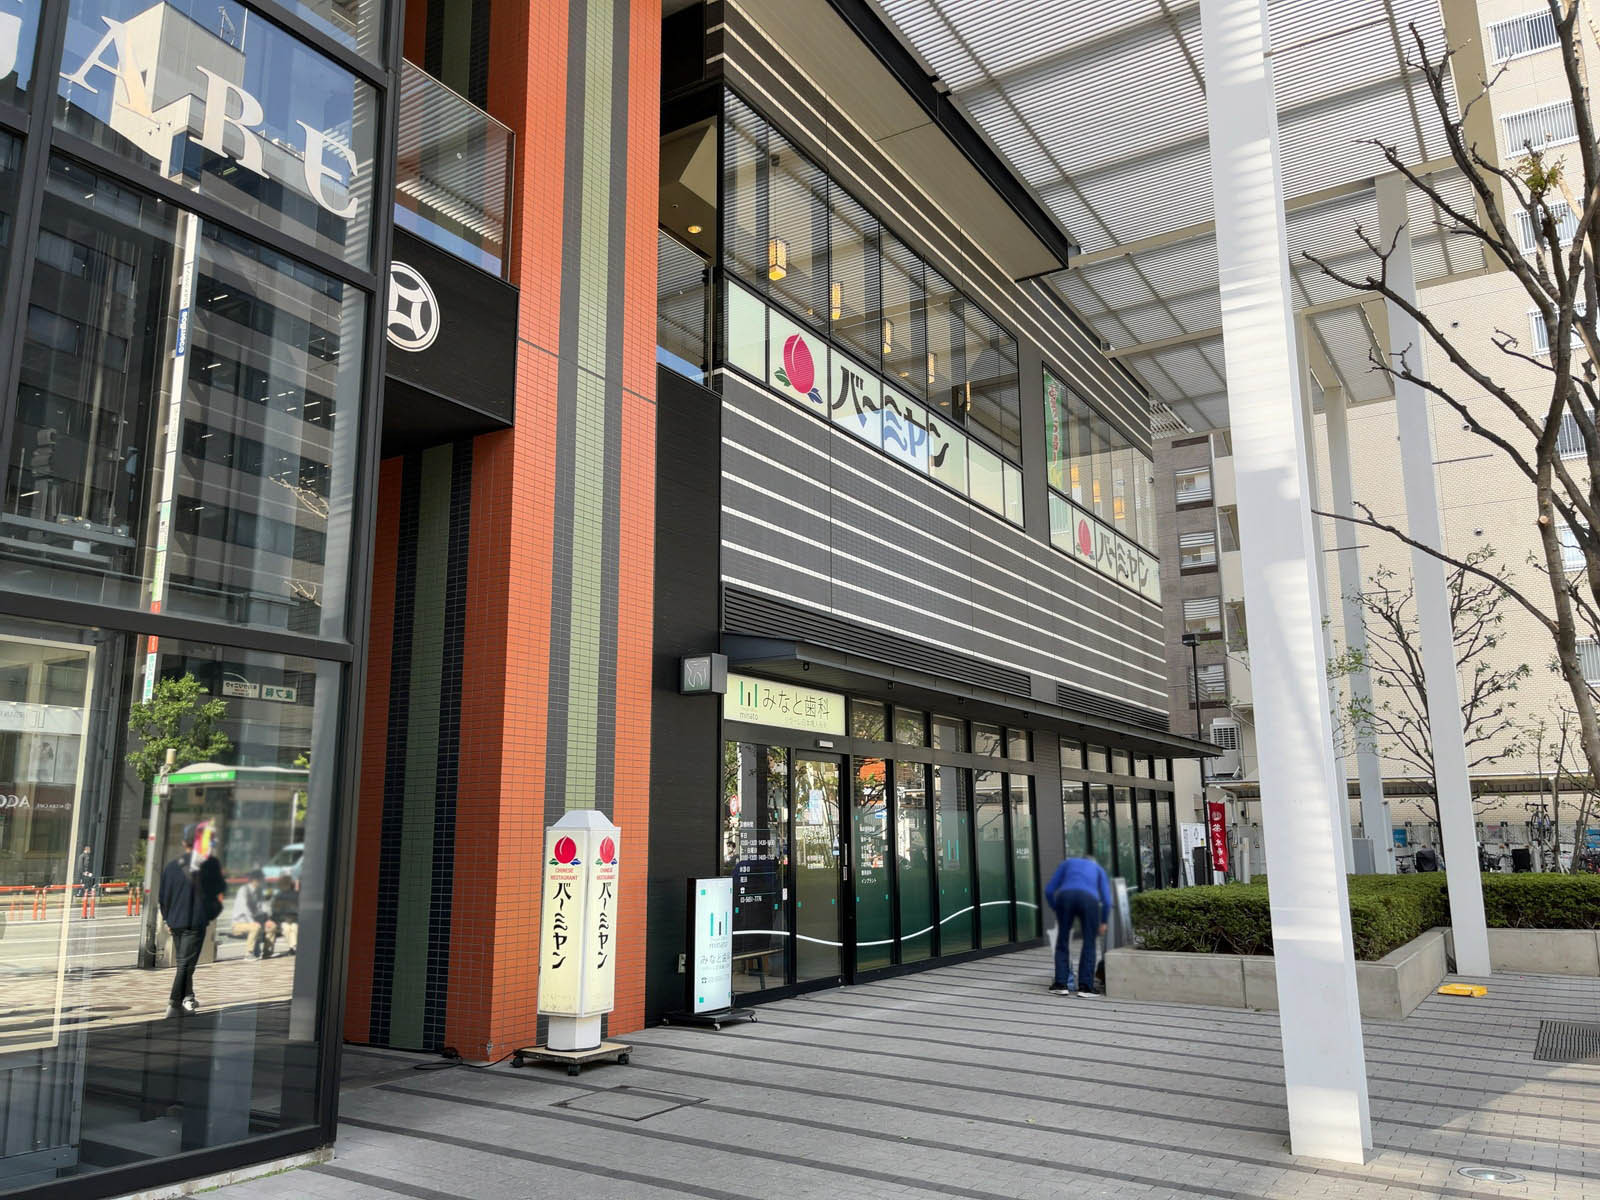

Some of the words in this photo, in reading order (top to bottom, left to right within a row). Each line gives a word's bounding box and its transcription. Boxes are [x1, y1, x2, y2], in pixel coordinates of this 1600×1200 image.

[832, 365, 950, 468] バーミヤン
[763, 689, 831, 720] みなと歯科
[552, 882, 572, 969] バーミヤン
[597, 881, 612, 969] バーミヤン
